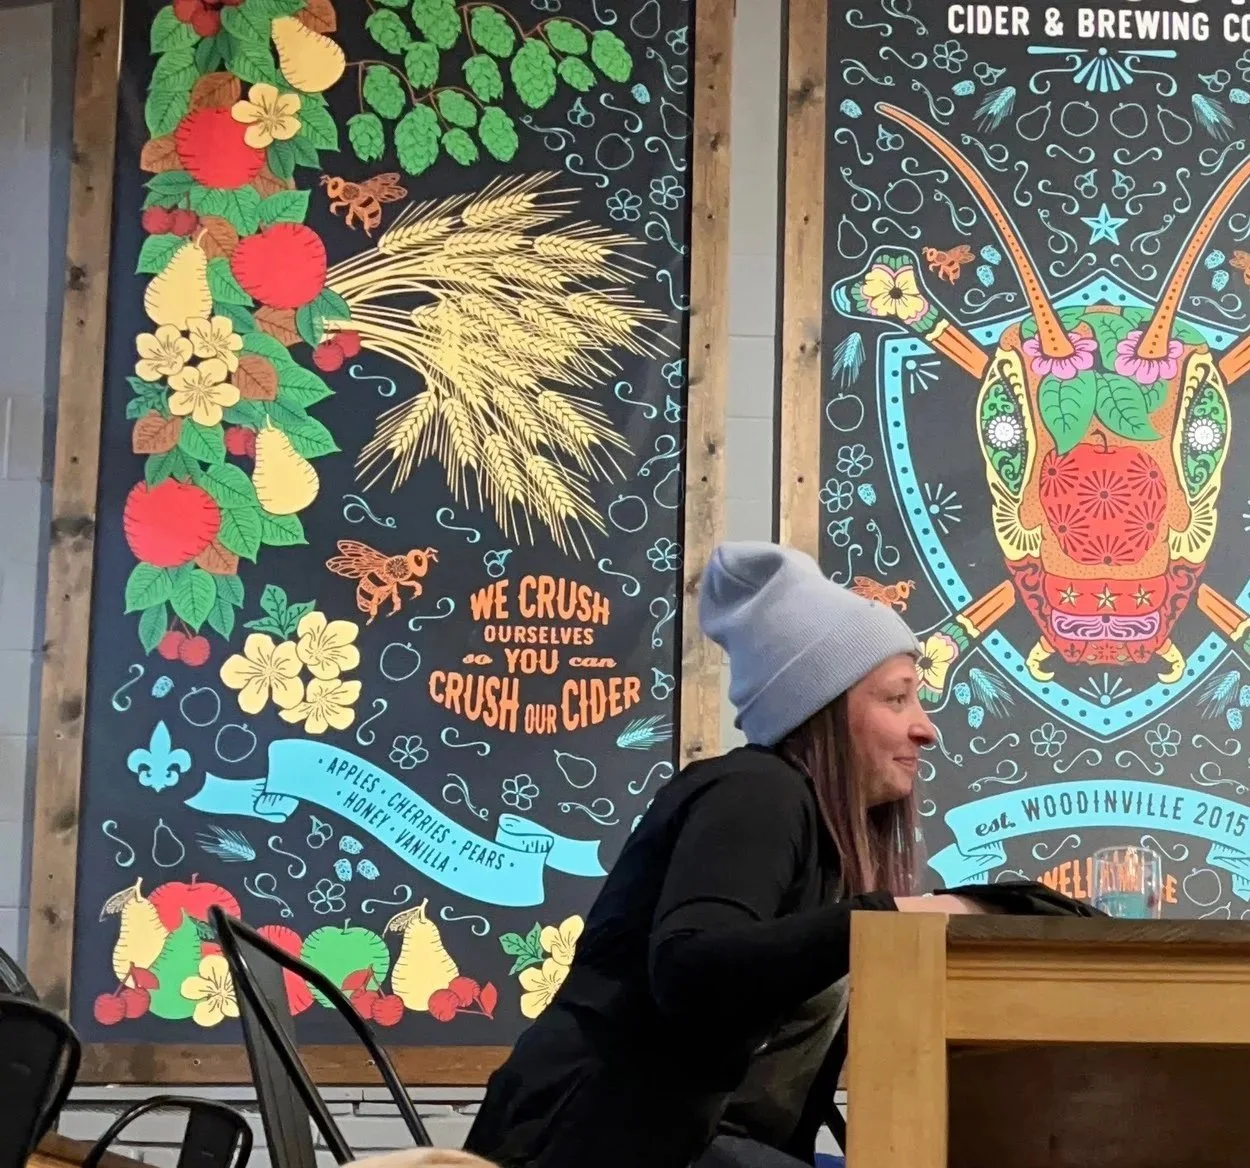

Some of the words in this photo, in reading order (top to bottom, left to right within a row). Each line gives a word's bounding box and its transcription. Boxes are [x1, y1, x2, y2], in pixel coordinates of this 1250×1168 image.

[948, 4, 1030, 36] CIDER
[1044, 7, 1064, 37] &
[1077, 8, 1210, 41] BREWING
[470, 579, 509, 621] WE
[518, 575, 610, 626] CRUSH
[483, 624, 594, 645] OURSELVES
[462, 653, 493, 665] so
[504, 648, 559, 674] YOU
[568, 656, 617, 668] can
[429, 670, 519, 733] CRUSH
[524, 703, 557, 734] OUR
[561, 676, 641, 731] CIDER
[326, 757, 381, 793] APPLES
[387, 792, 450, 845] CHERRIES
[458, 840, 507, 870] PEARS
[343, 791, 391, 829] HONEY
[394, 828, 450, 872] VANILLA
[975, 812, 1017, 837] est.
[1021, 790, 1184, 822] WOODINVILLE
[1193, 802, 1249, 837] 2015
